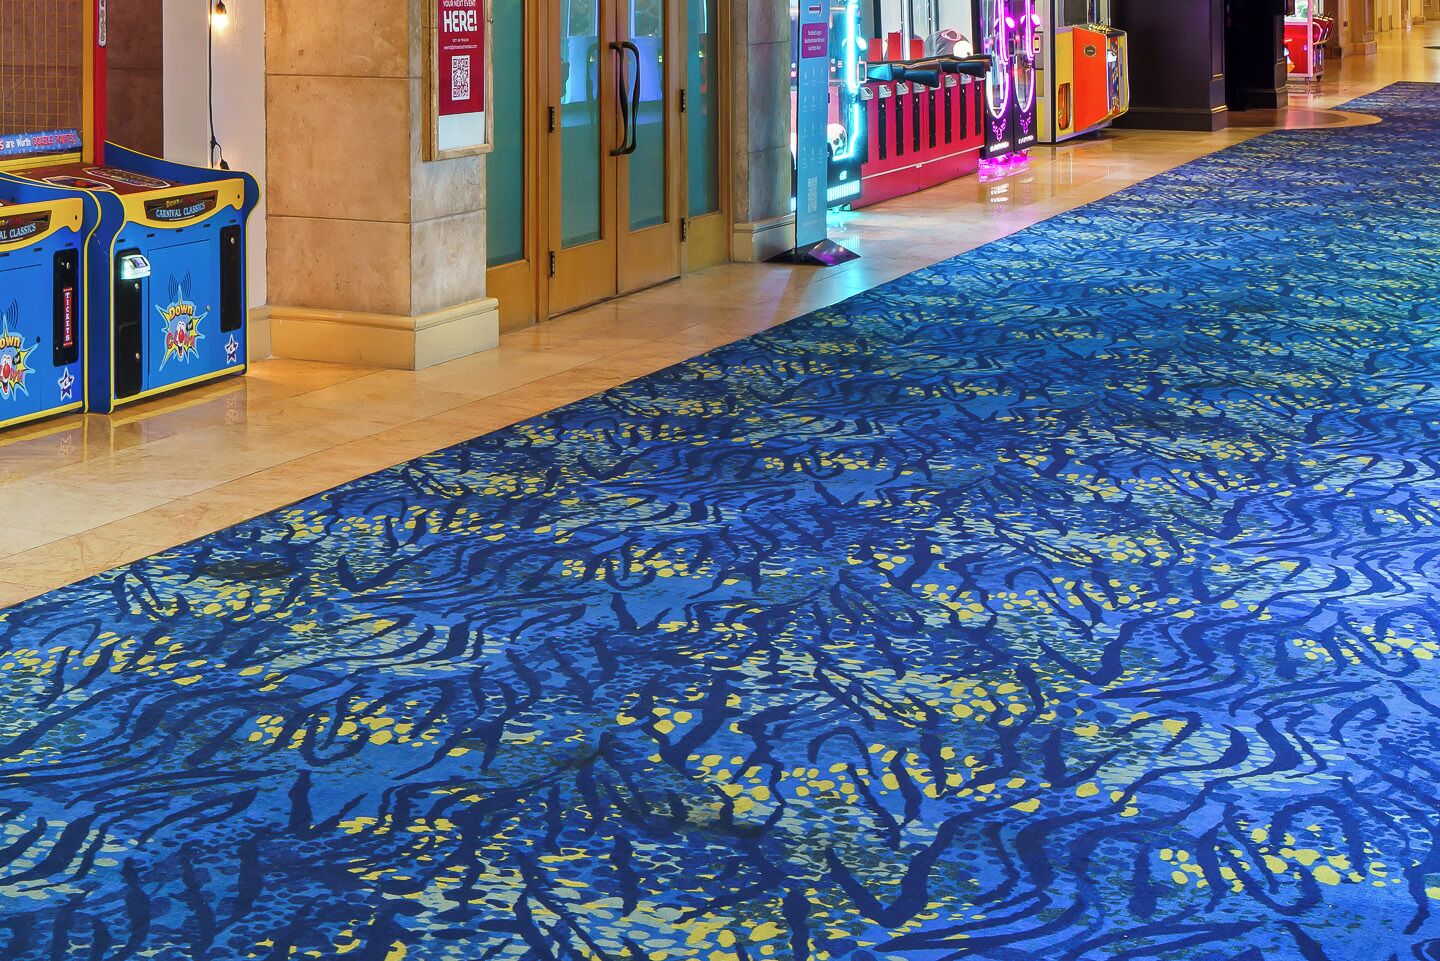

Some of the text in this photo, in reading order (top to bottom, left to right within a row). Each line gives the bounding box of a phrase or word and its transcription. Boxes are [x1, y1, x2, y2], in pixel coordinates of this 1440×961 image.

[442, 0, 454, 8] YOUR
[443, 9, 478, 33] HERE!
[5, 140, 15, 148] are
[16, 136, 31, 148] Worth
[155, 202, 206, 219] CARNIVAL CLASSICS
[9, 222, 37, 239] CLASSICS
